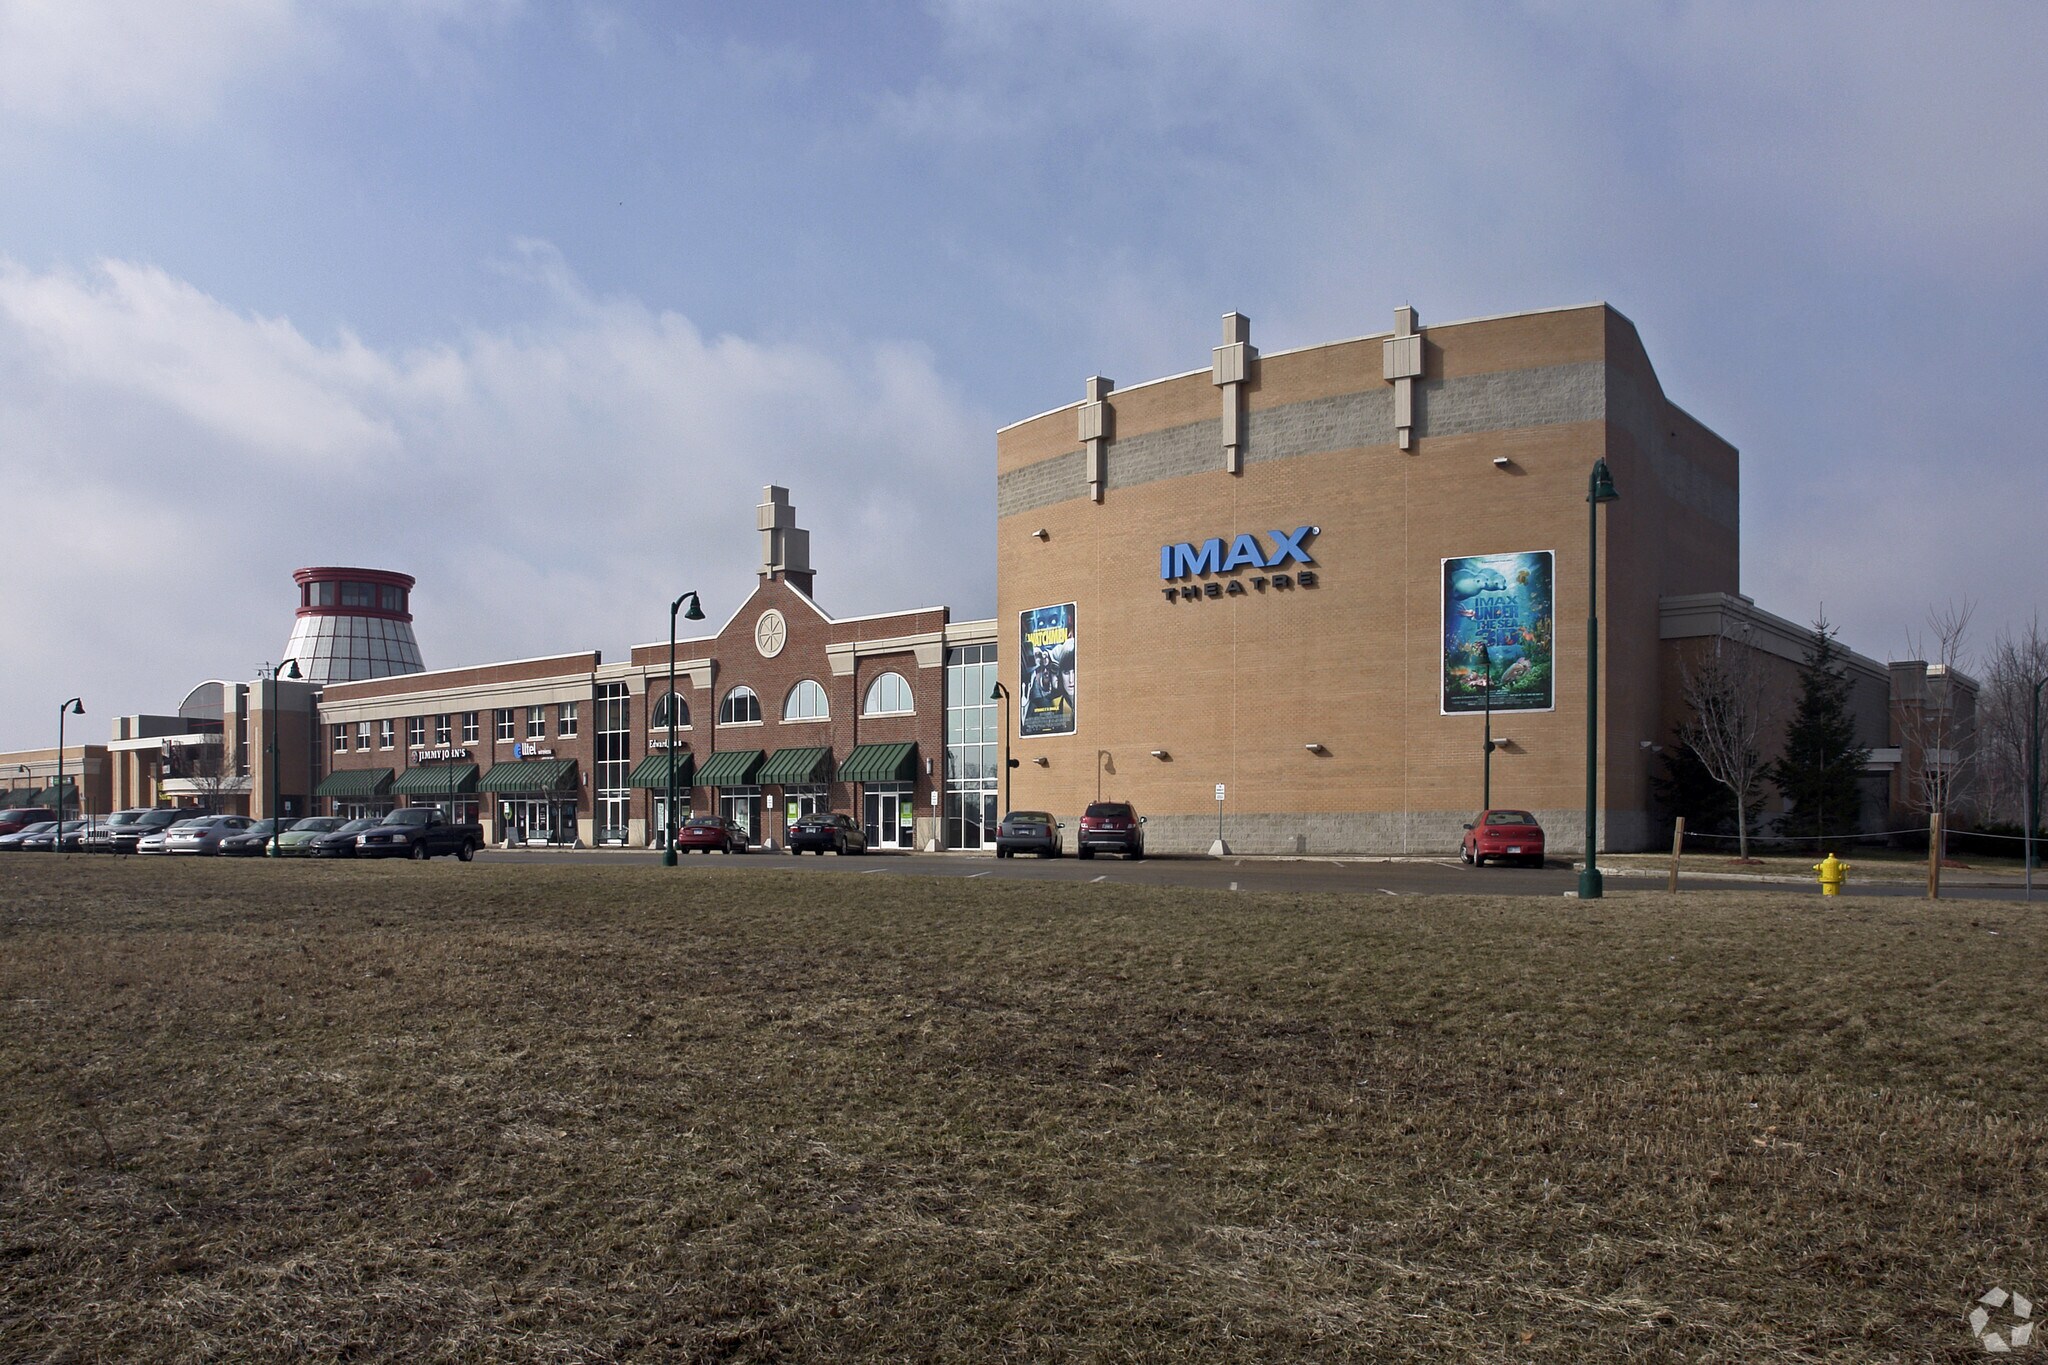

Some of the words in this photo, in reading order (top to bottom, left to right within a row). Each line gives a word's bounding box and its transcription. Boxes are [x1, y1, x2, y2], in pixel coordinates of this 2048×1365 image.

[1162, 571, 1315, 601] THEATRE
[1475, 595, 1519, 607] IMAX
[1475, 605, 1519, 620] UNDER
[1476, 619, 1497, 630] THE
[1499, 618, 1519, 629] SEA
[1475, 629, 1520, 647] 3D
[418, 749, 442, 762] JIMMY
